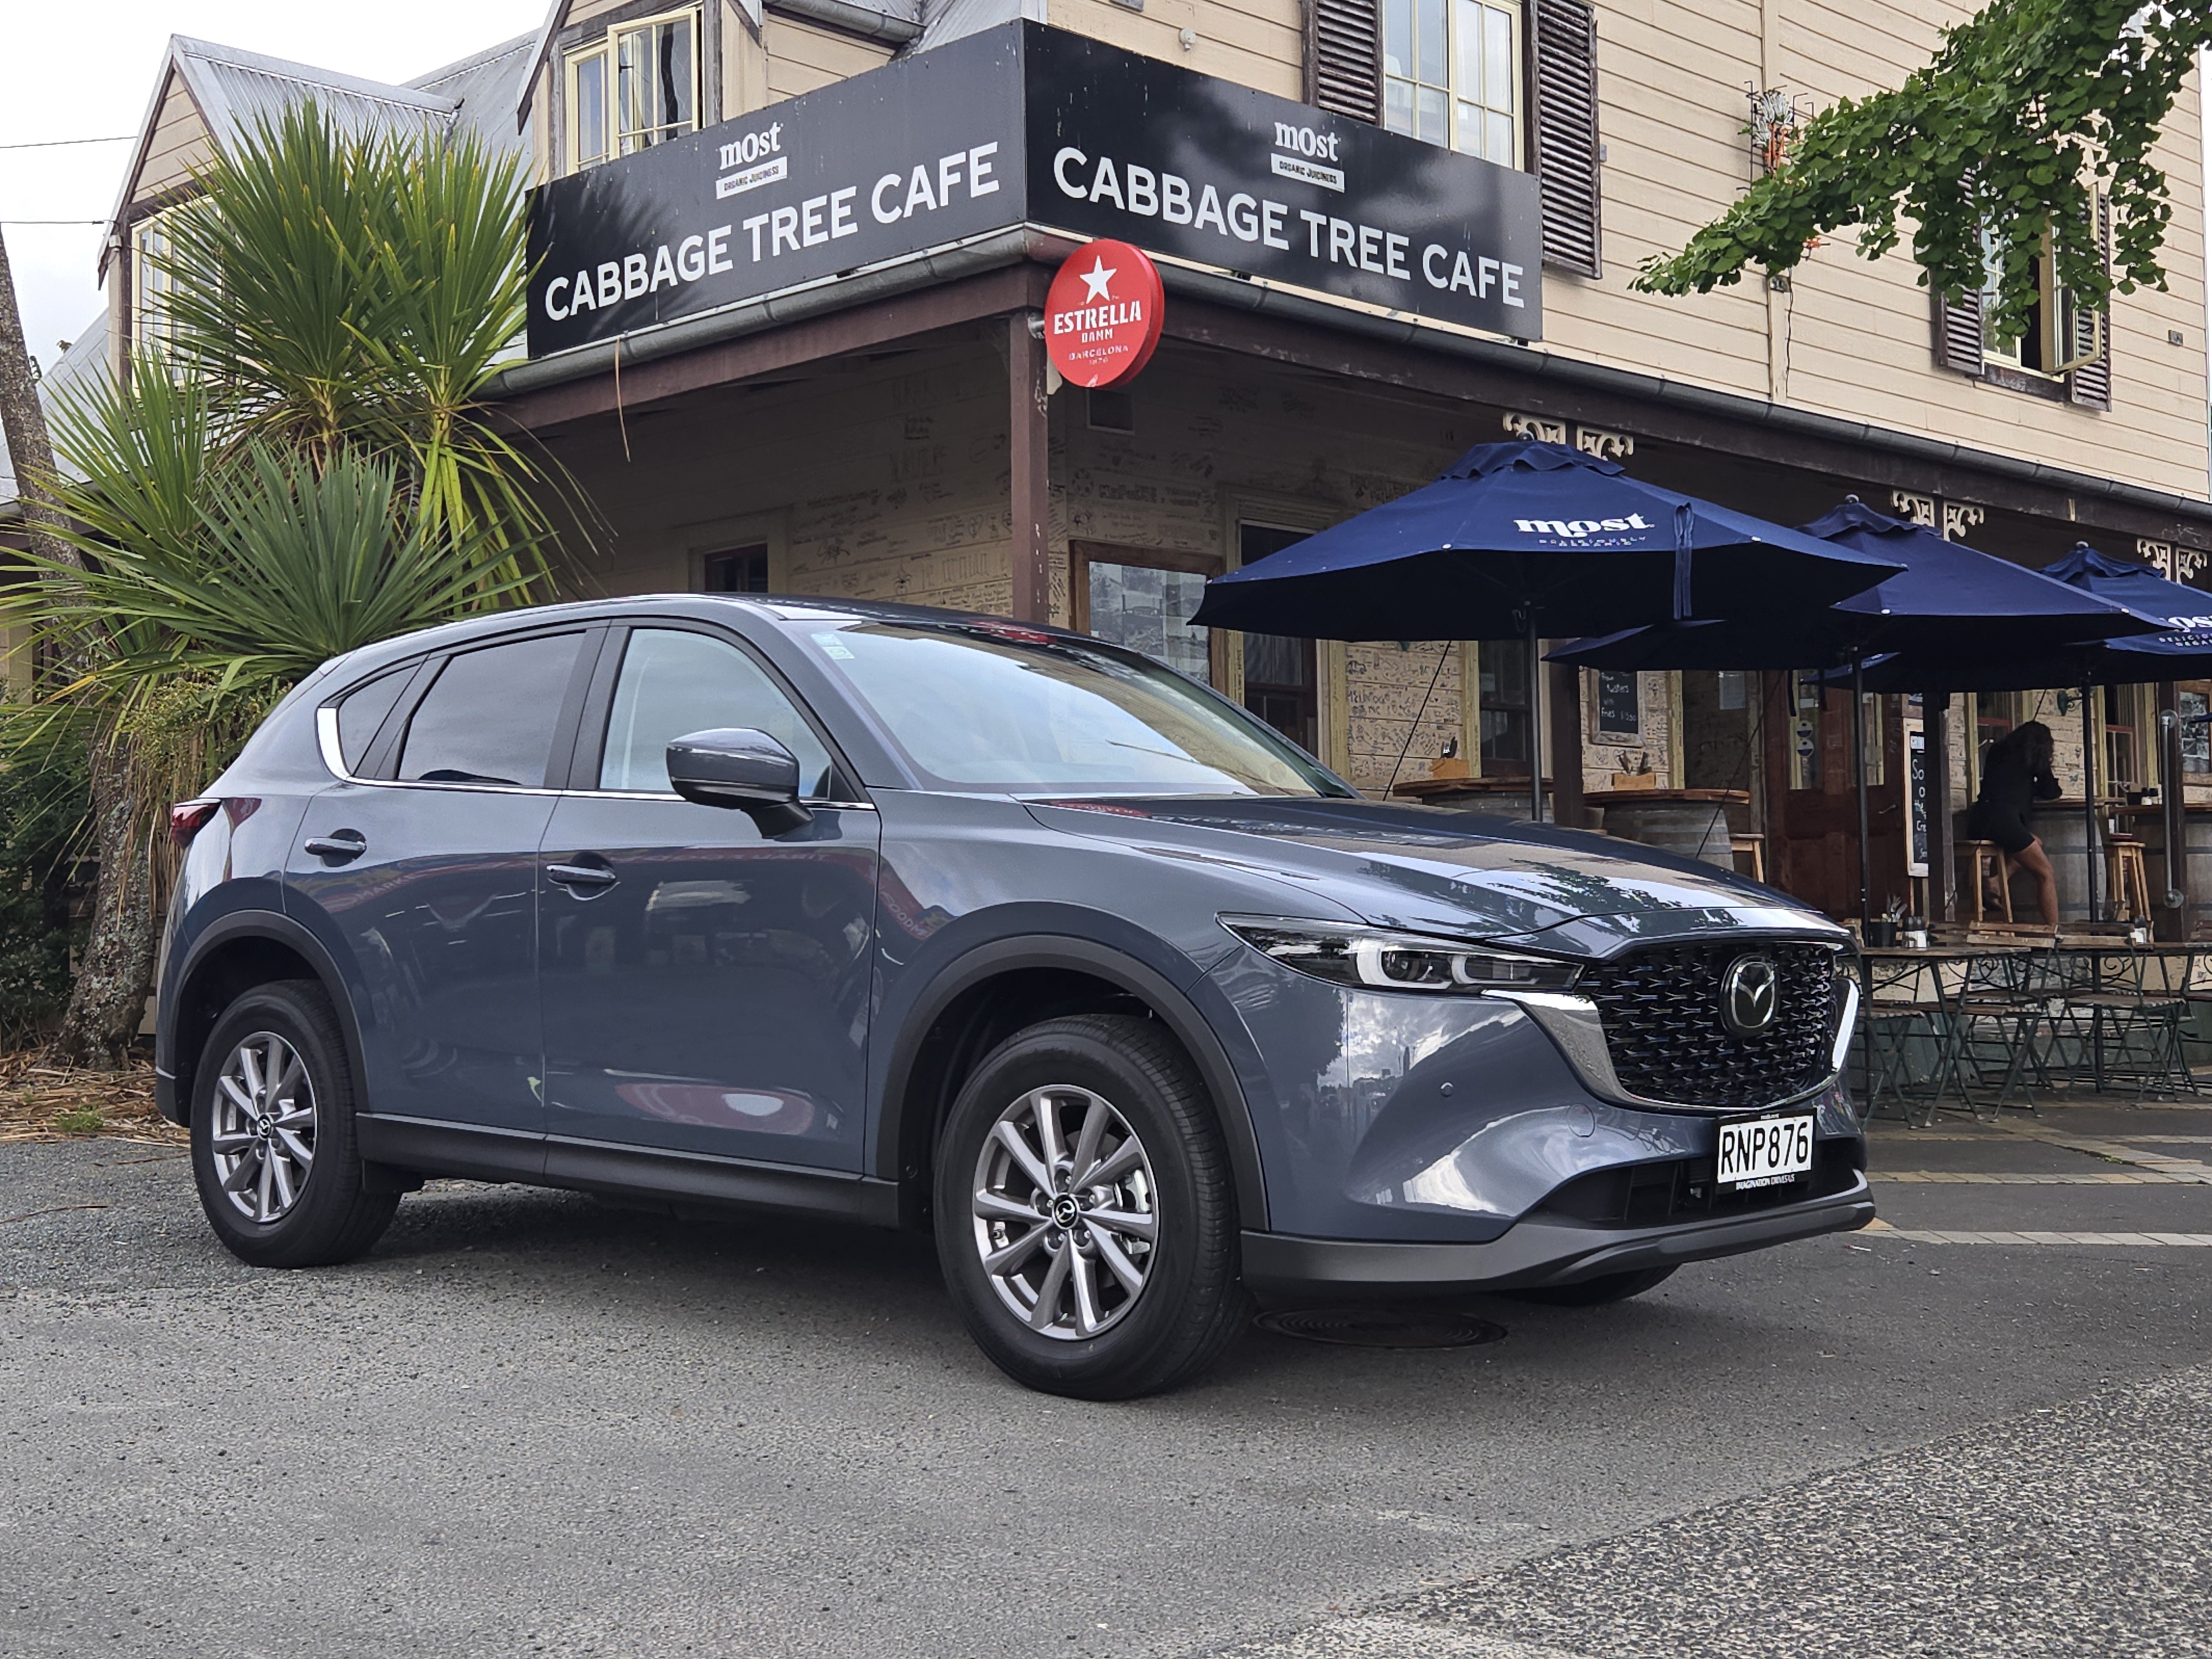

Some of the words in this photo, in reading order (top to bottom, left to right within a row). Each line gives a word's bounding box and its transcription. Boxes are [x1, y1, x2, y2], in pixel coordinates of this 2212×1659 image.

[546, 225, 733, 321] CABBAGE
[743, 186, 858, 262] TREE
[872, 142, 1000, 223] CAFE
[1054, 147, 1289, 250] CABBAGE
[1300, 210, 1411, 280] TREE
[1423, 244, 1525, 309] CAFE
[1053, 300, 1142, 334] ESTRELLA
[1082, 328, 1113, 343] DAMM
[1068, 345, 1129, 361] BARCELONA
[1721, 1121, 1808, 1175] RNP876
